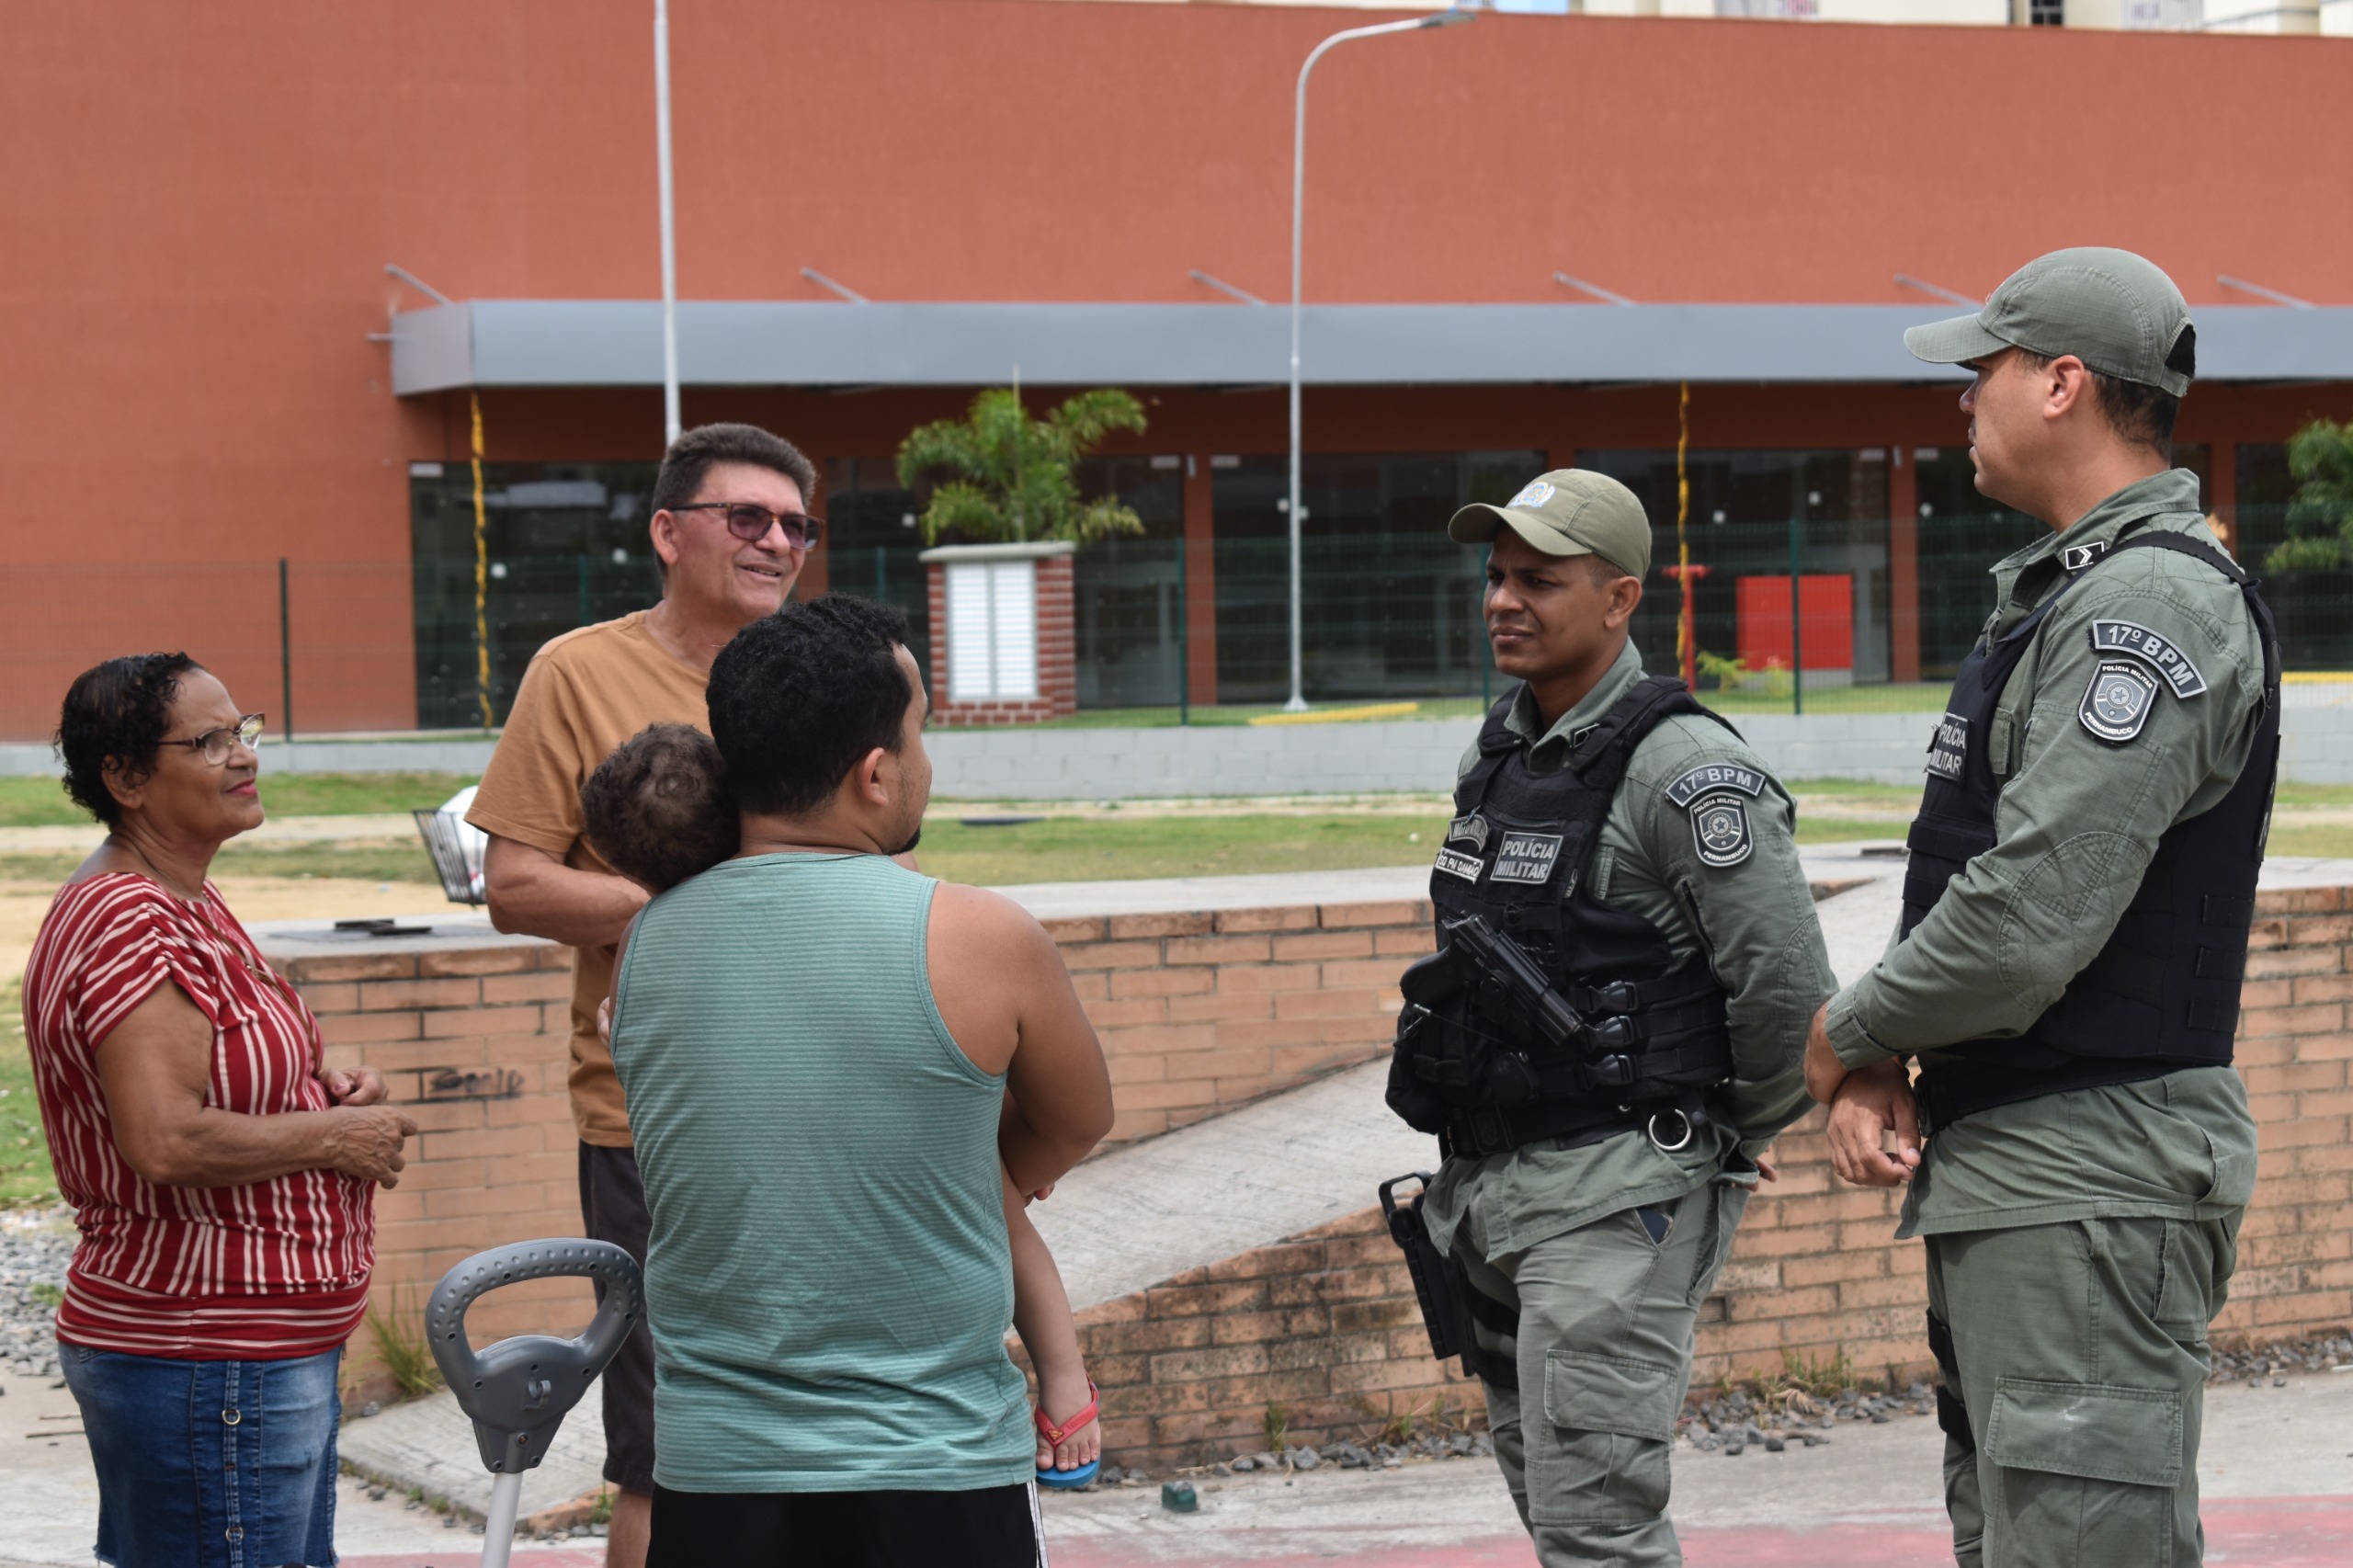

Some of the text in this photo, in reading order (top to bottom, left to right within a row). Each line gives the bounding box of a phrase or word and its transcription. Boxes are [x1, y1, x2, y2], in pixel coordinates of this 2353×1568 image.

[2141, 635, 2195, 687] BPM
[2102, 665, 2153, 689] POLÍCIA MILITAR
[2085, 711, 2133, 734] PERNAMBUCO
[1707, 767, 1752, 788] BPM
[1694, 798, 1741, 813] POLÍCIA MILITAR
[1502, 838, 1555, 859] POLÍCIA
[1703, 844, 1748, 861] PERNAMBUCO
[1495, 860, 1550, 880] MILITAR
